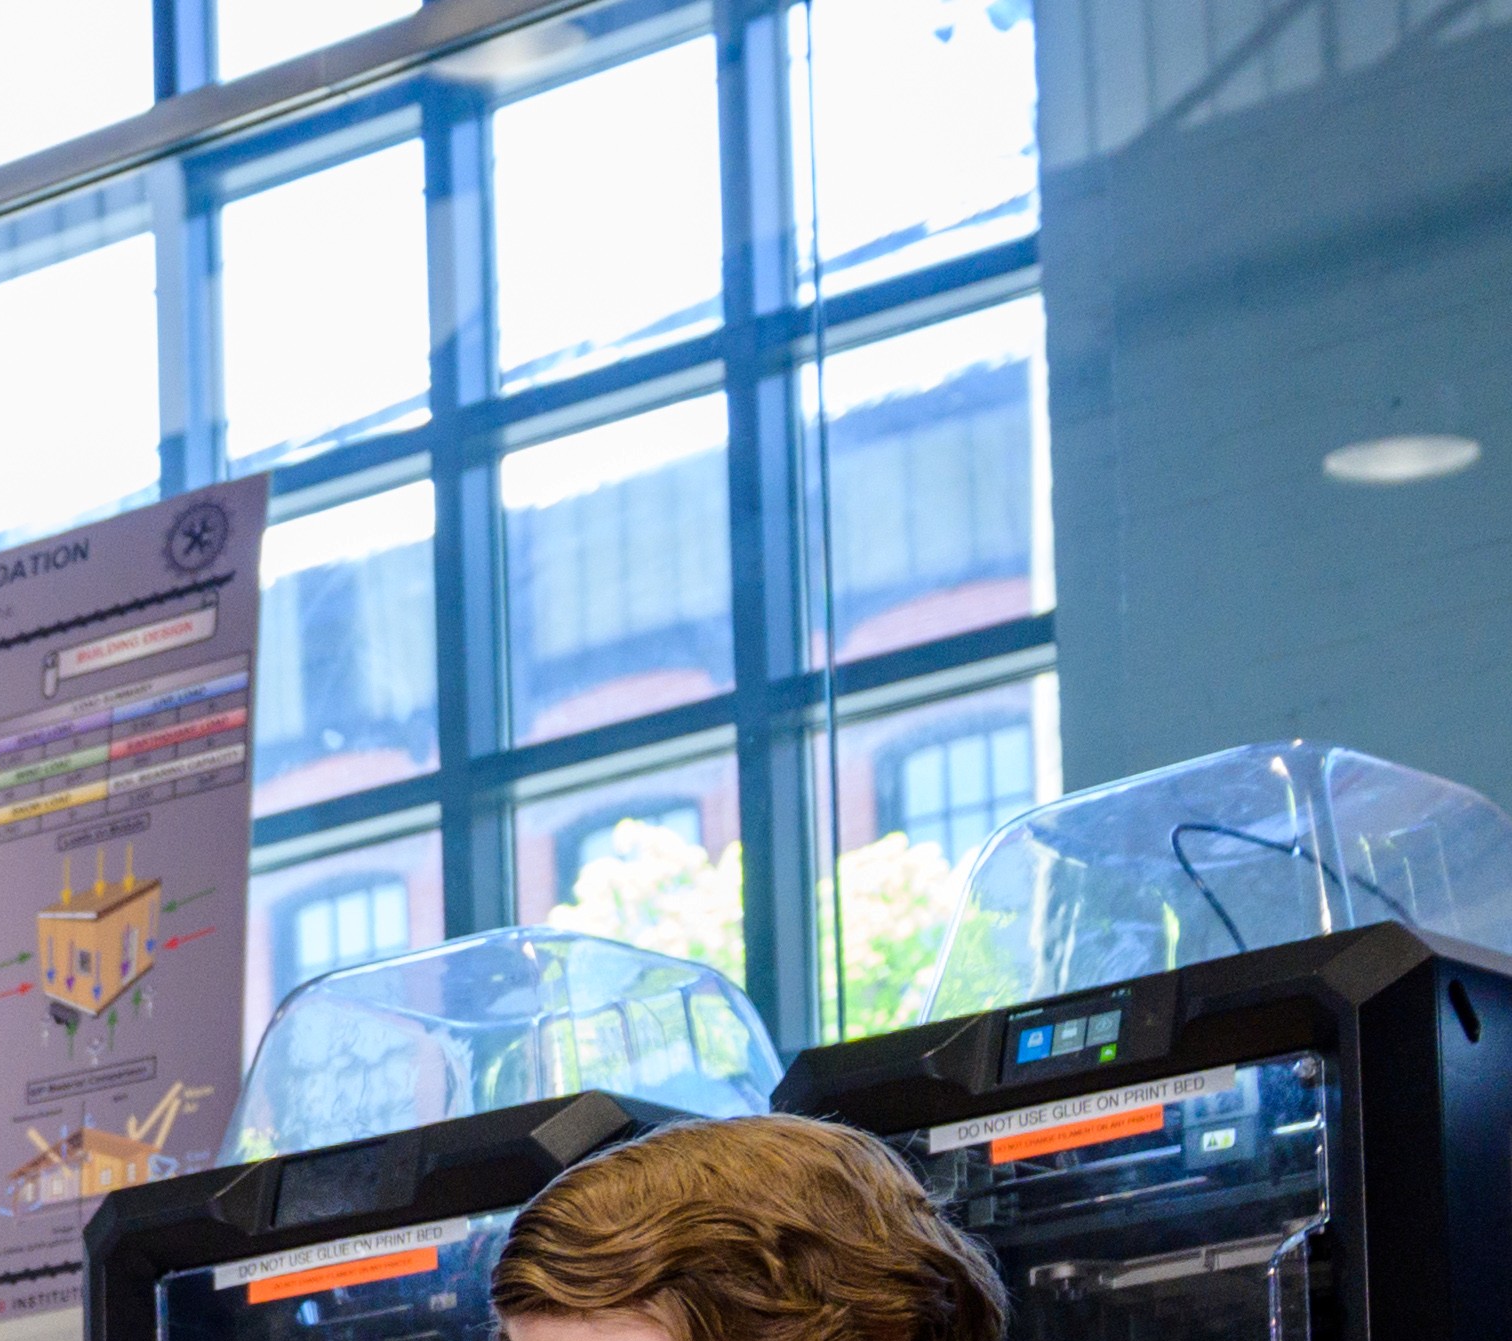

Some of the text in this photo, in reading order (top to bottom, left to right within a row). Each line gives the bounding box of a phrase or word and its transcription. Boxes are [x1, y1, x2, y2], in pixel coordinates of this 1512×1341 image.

[76, 621, 194, 665] BUILDING DESIGN
[957, 1076, 1206, 1141] DO NOT USE GLUE ON PRINT BED
[238, 1226, 443, 1279] DO NOT USE GLUE ON PRINT BED
